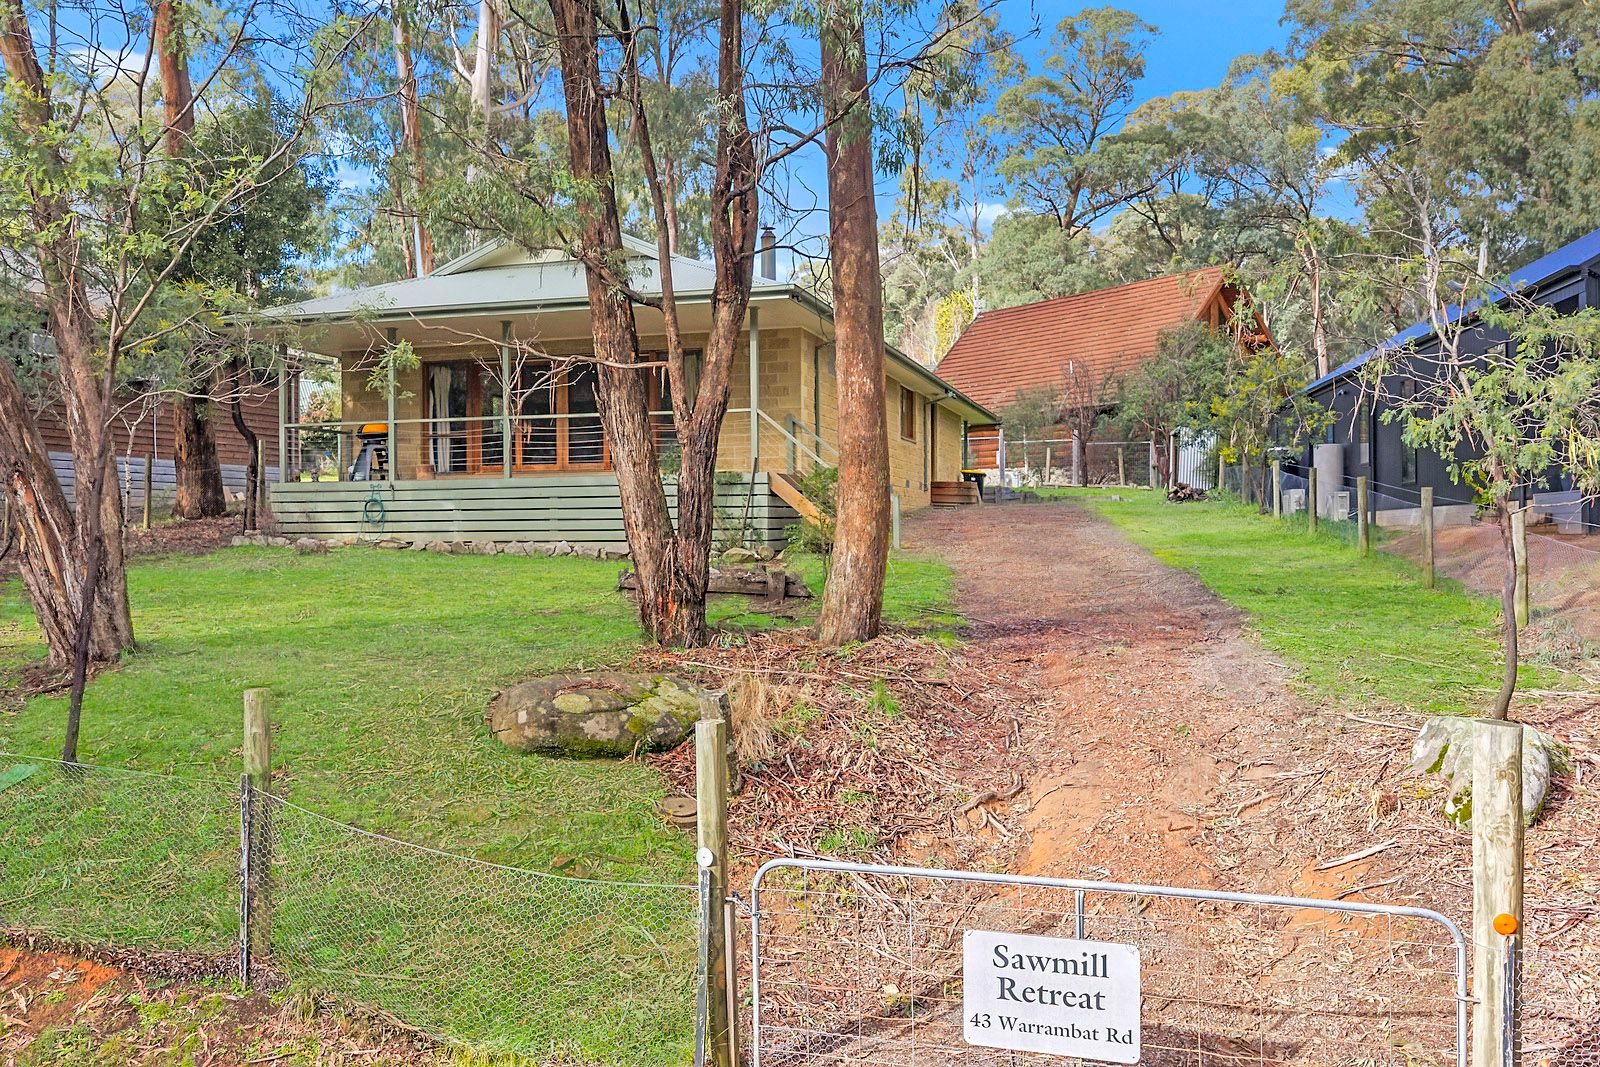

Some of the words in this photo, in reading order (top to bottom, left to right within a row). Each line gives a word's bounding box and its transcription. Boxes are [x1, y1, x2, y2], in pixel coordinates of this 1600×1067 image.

[992, 944, 1110, 979] Sawmill
[996, 976, 1106, 1011] Retreat
[969, 1012, 992, 1029] 43
[998, 1015, 1100, 1041] Warrambat
[1106, 1027, 1134, 1045] Rd
